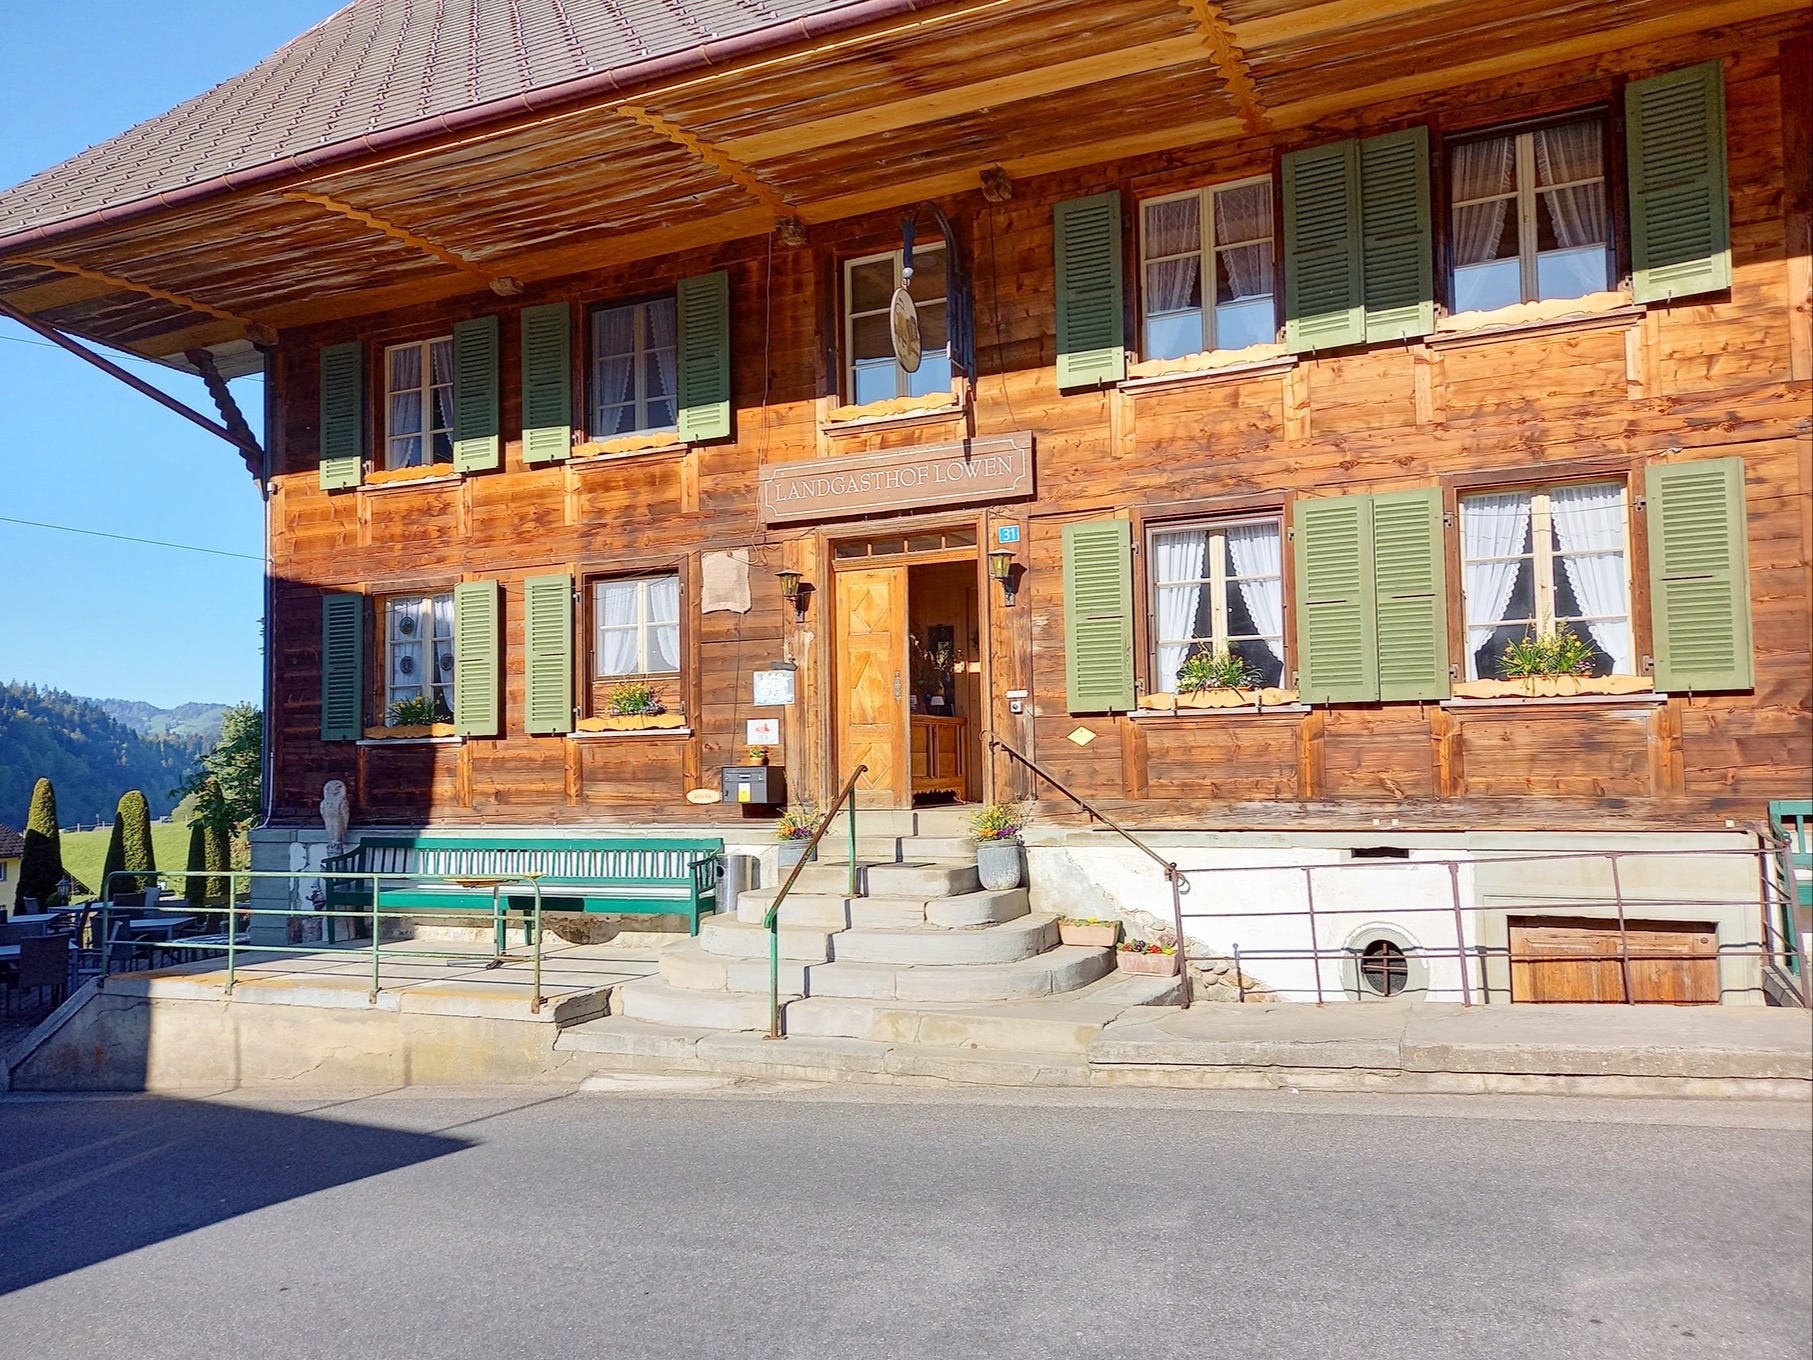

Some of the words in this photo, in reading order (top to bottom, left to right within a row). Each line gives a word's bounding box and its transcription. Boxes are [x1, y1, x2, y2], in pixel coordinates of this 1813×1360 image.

[774, 466, 930, 502] LANDGASTHOF
[934, 455, 1014, 483] LÖWEN
[1003, 527, 1015, 541] 31
